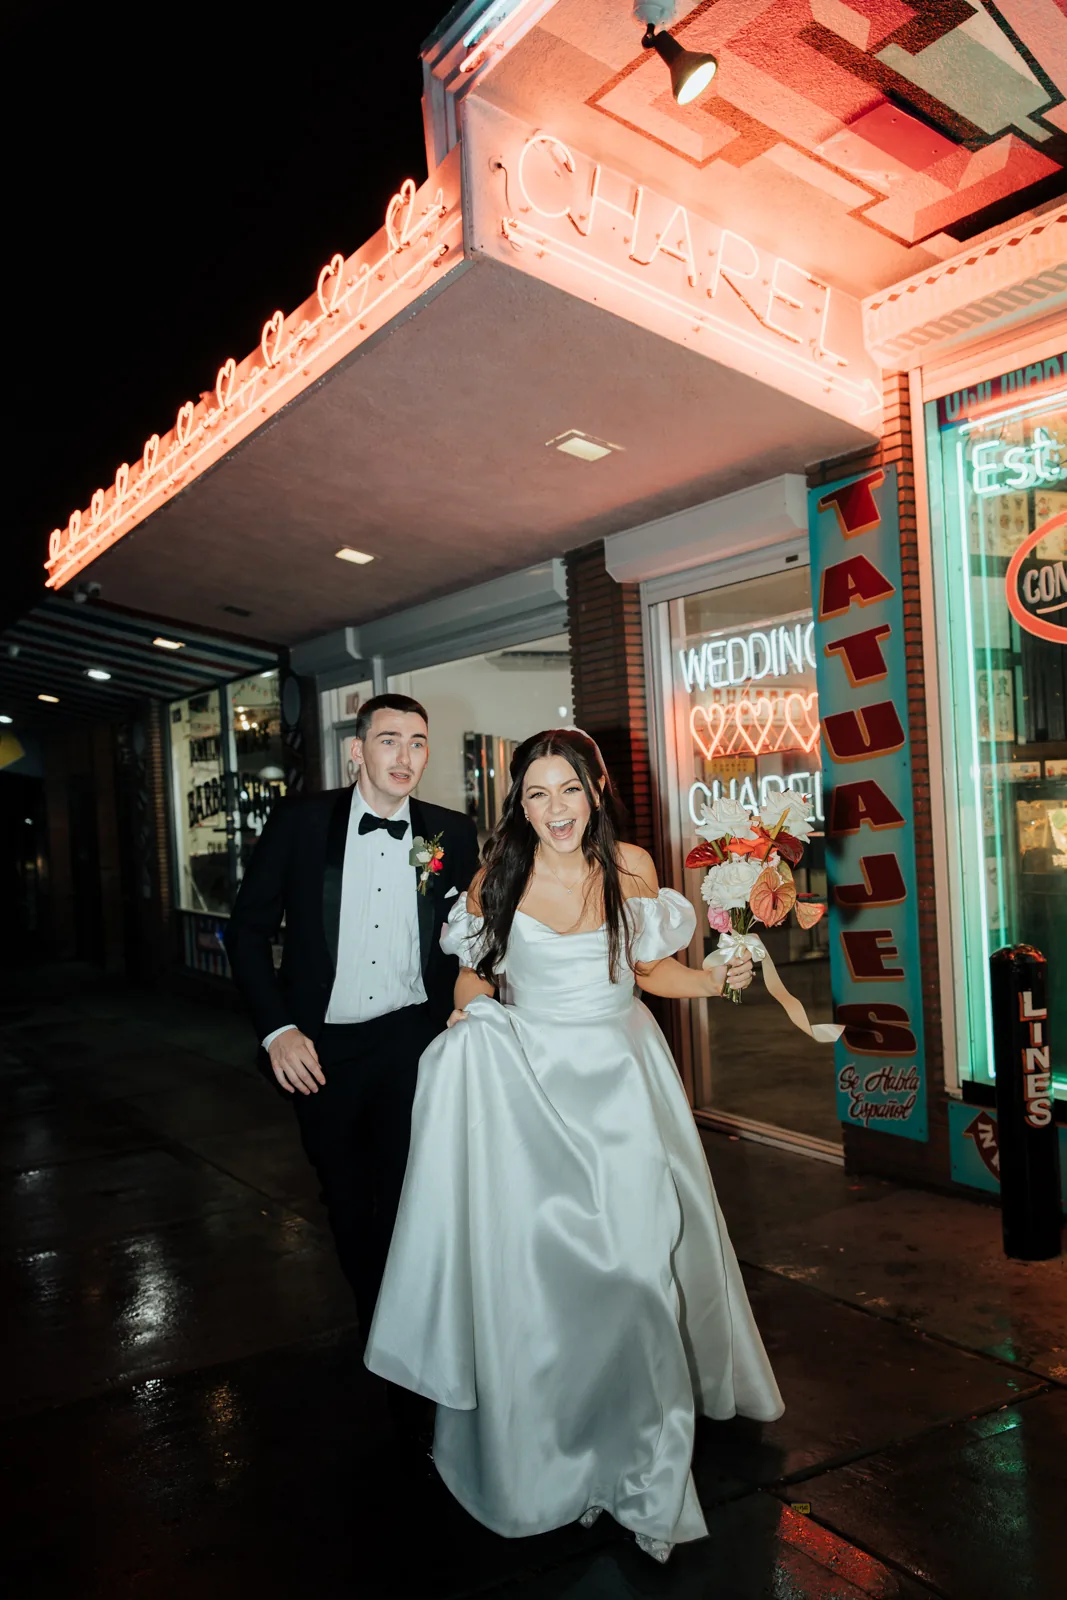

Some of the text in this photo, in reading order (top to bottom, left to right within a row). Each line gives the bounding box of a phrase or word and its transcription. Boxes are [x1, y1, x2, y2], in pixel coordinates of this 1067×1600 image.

[518, 134, 849, 367] CHAPEL
[972, 427, 1061, 495] Est.
[817, 468, 918, 1058] TATUAJES
[838, 1063, 920, 1094] Se Habla
[847, 1091, 917, 1127] Español
[1018, 991, 1052, 1128] LINES
